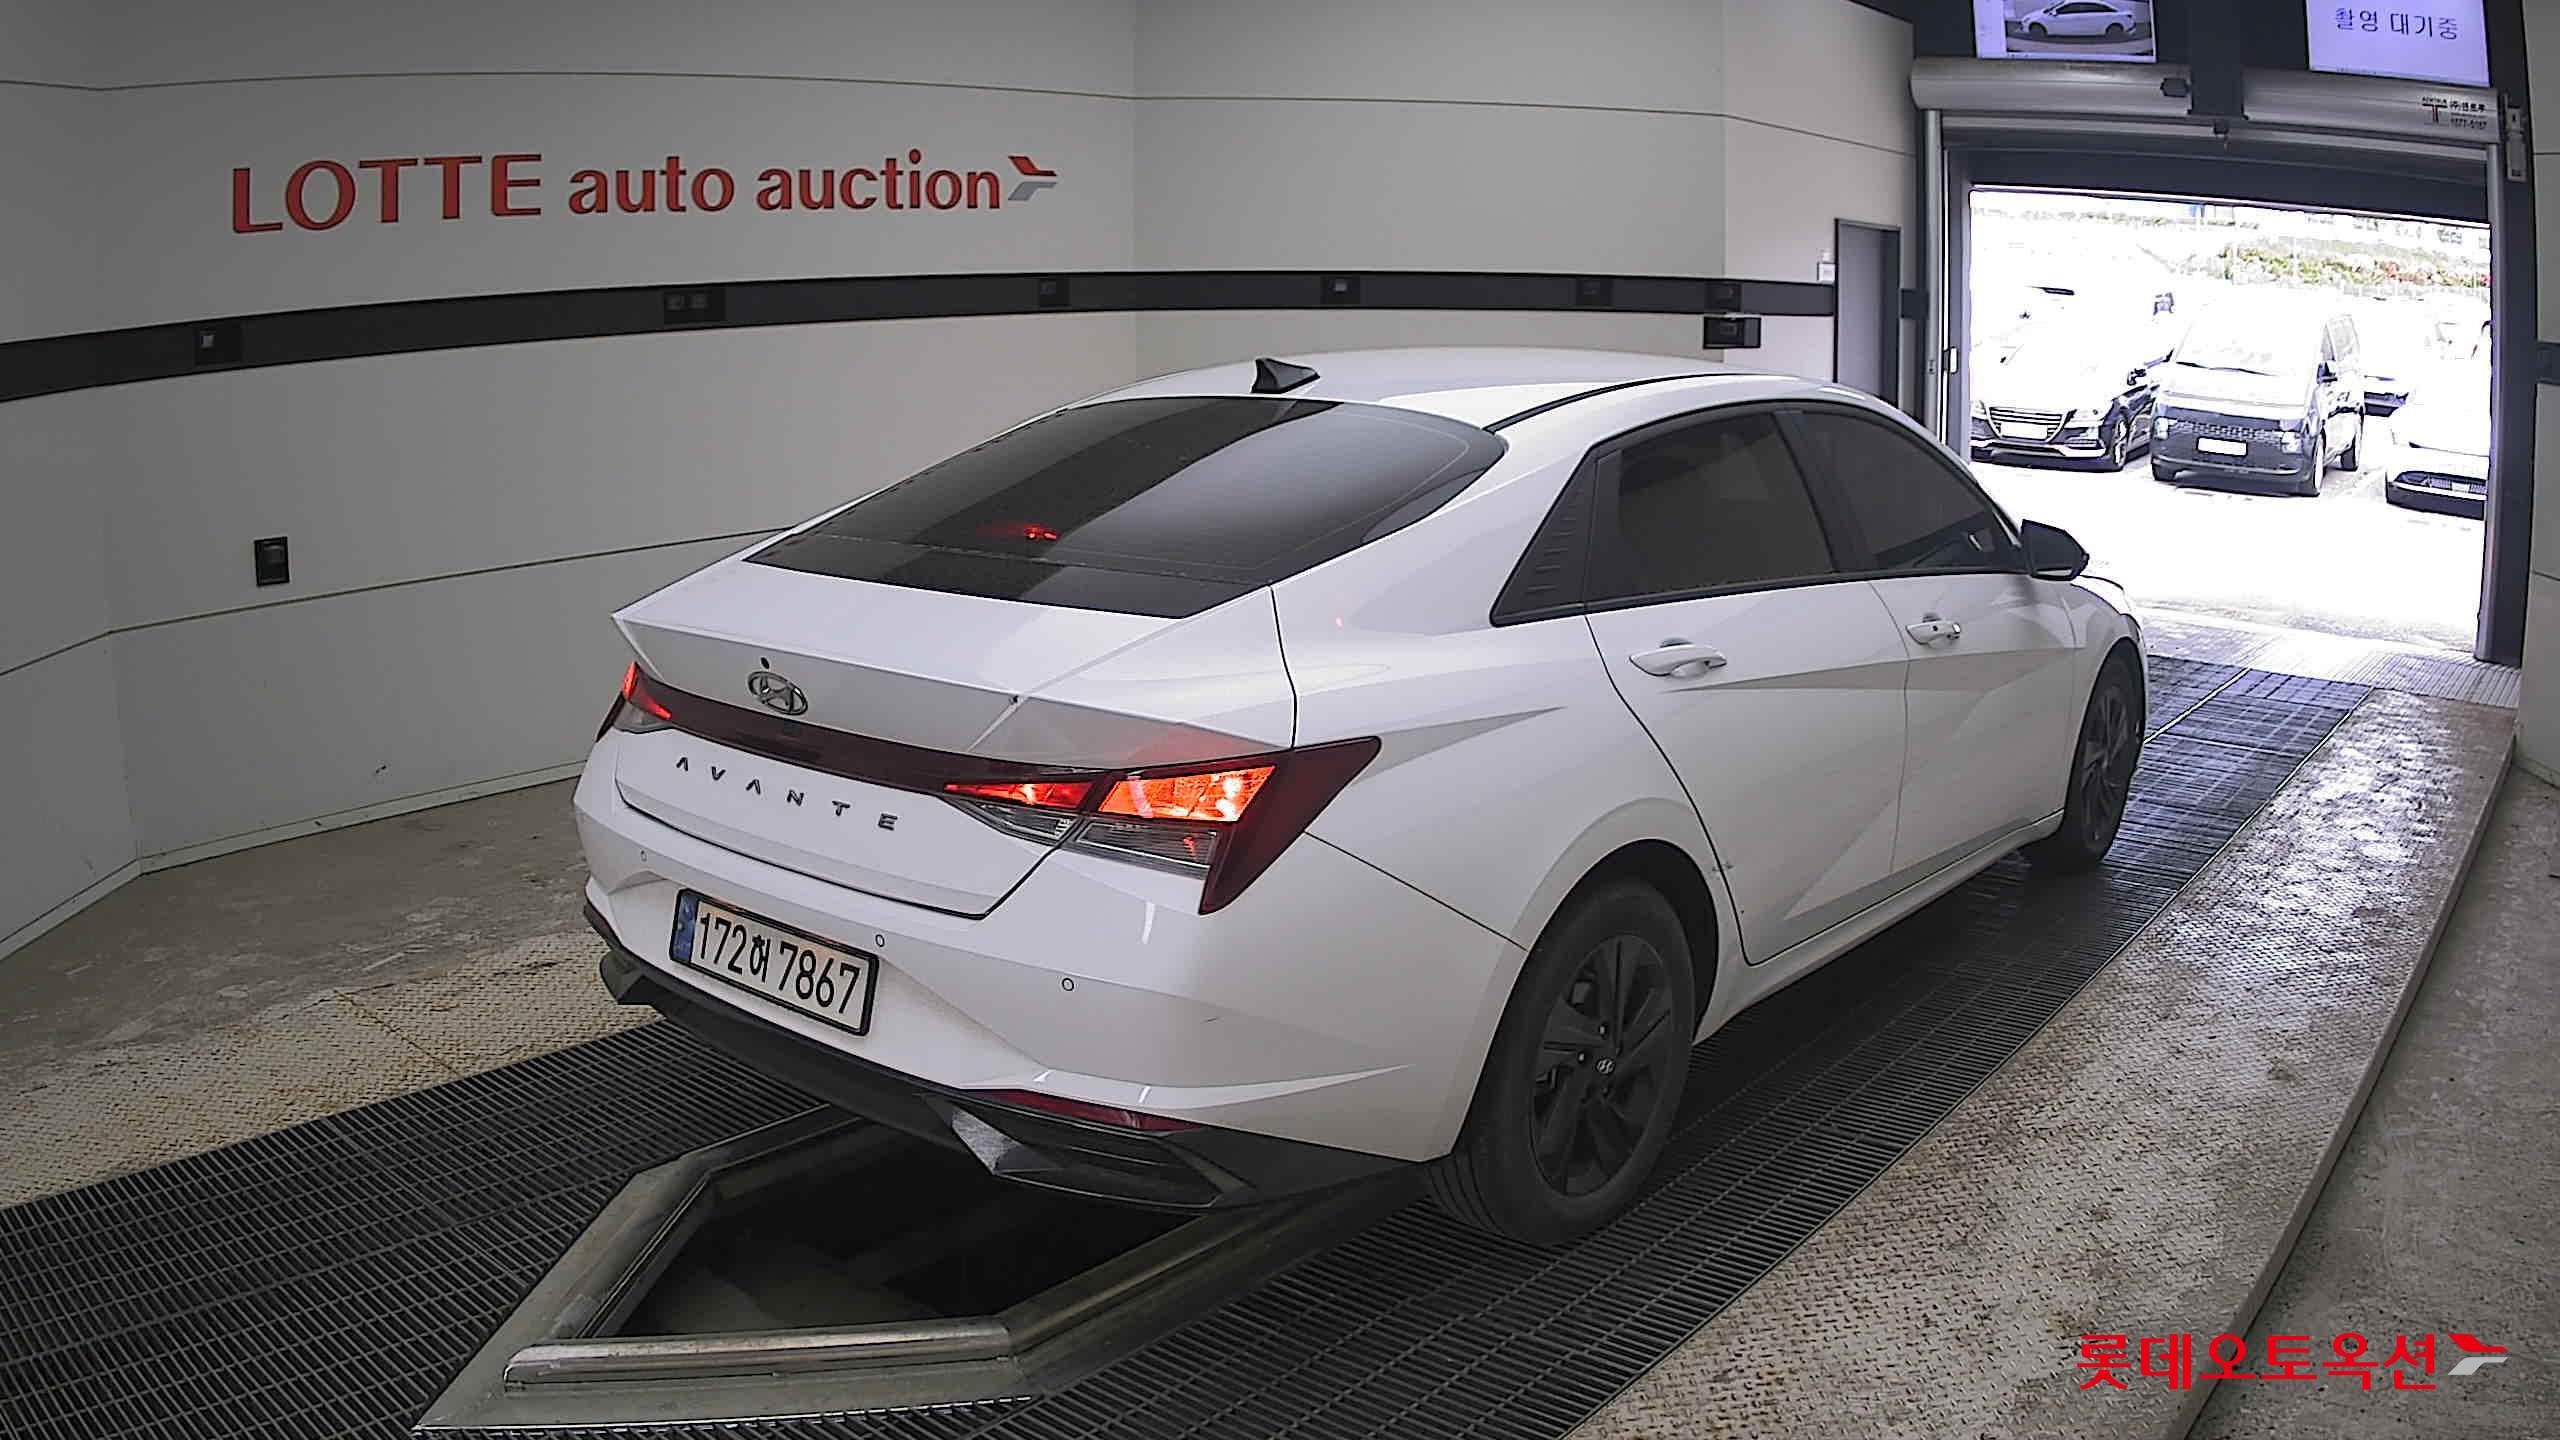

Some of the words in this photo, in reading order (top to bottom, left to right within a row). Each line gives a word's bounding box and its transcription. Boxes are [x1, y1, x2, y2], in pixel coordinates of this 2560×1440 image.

[233, 153, 543, 234] LOTTE
[568, 155, 735, 214] auto
[756, 148, 1001, 210] auction
[675, 756, 899, 831] AVANTE
[778, 940, 860, 1014] 7867
